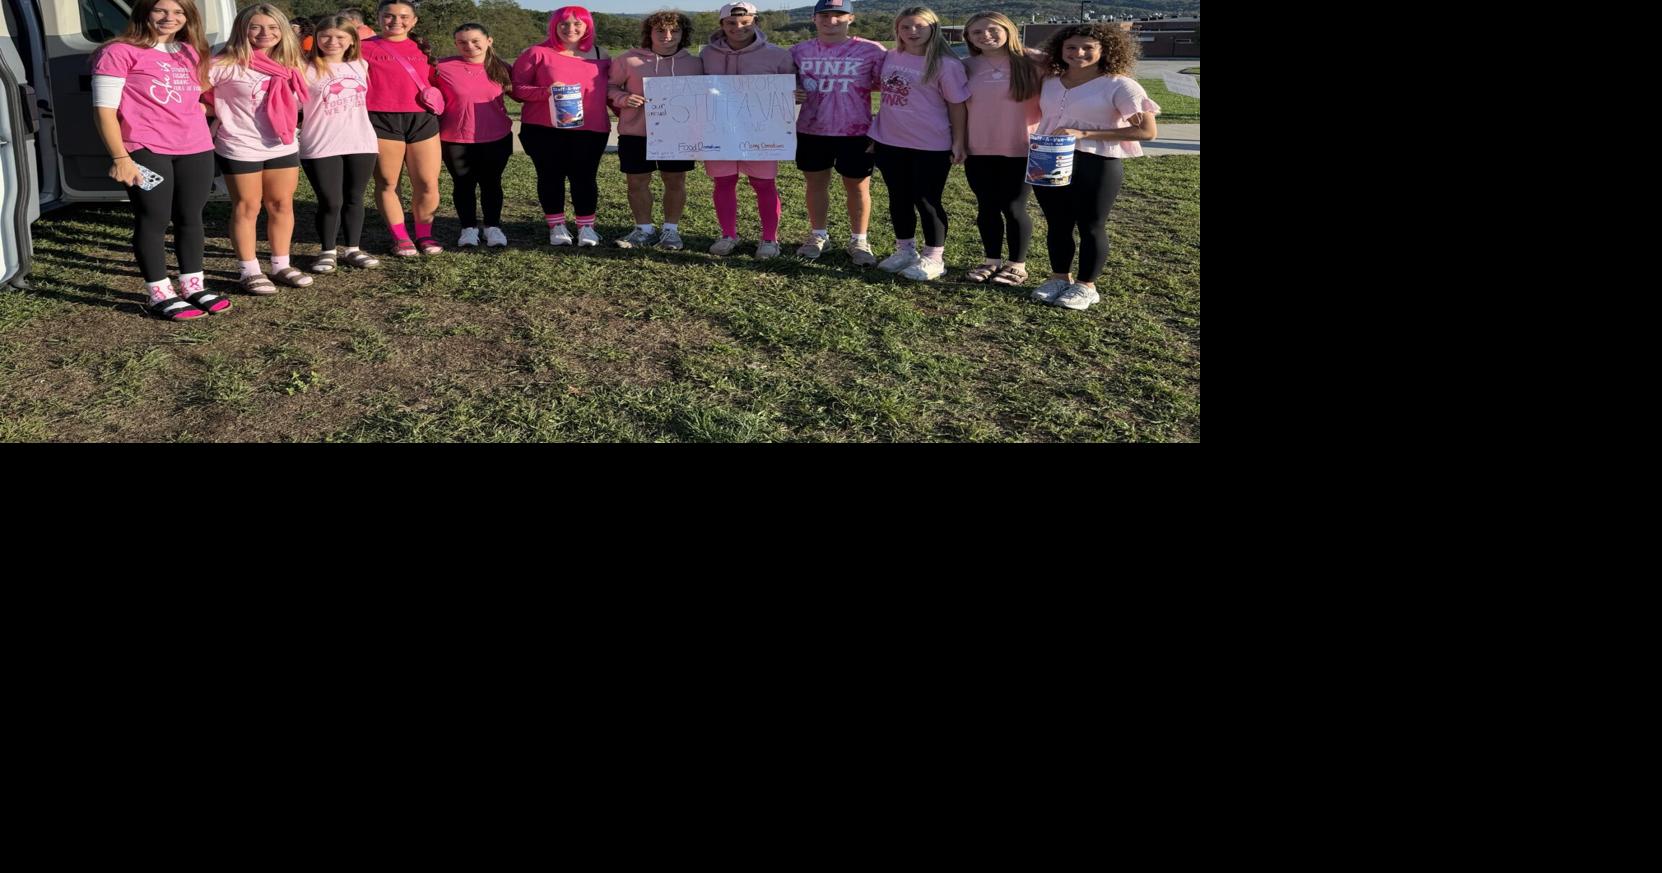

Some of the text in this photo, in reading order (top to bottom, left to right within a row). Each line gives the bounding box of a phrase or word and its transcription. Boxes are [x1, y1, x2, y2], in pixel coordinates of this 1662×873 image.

[800, 60, 862, 75] PINK
[150, 74, 182, 104] She
[678, 142, 698, 152] Food
